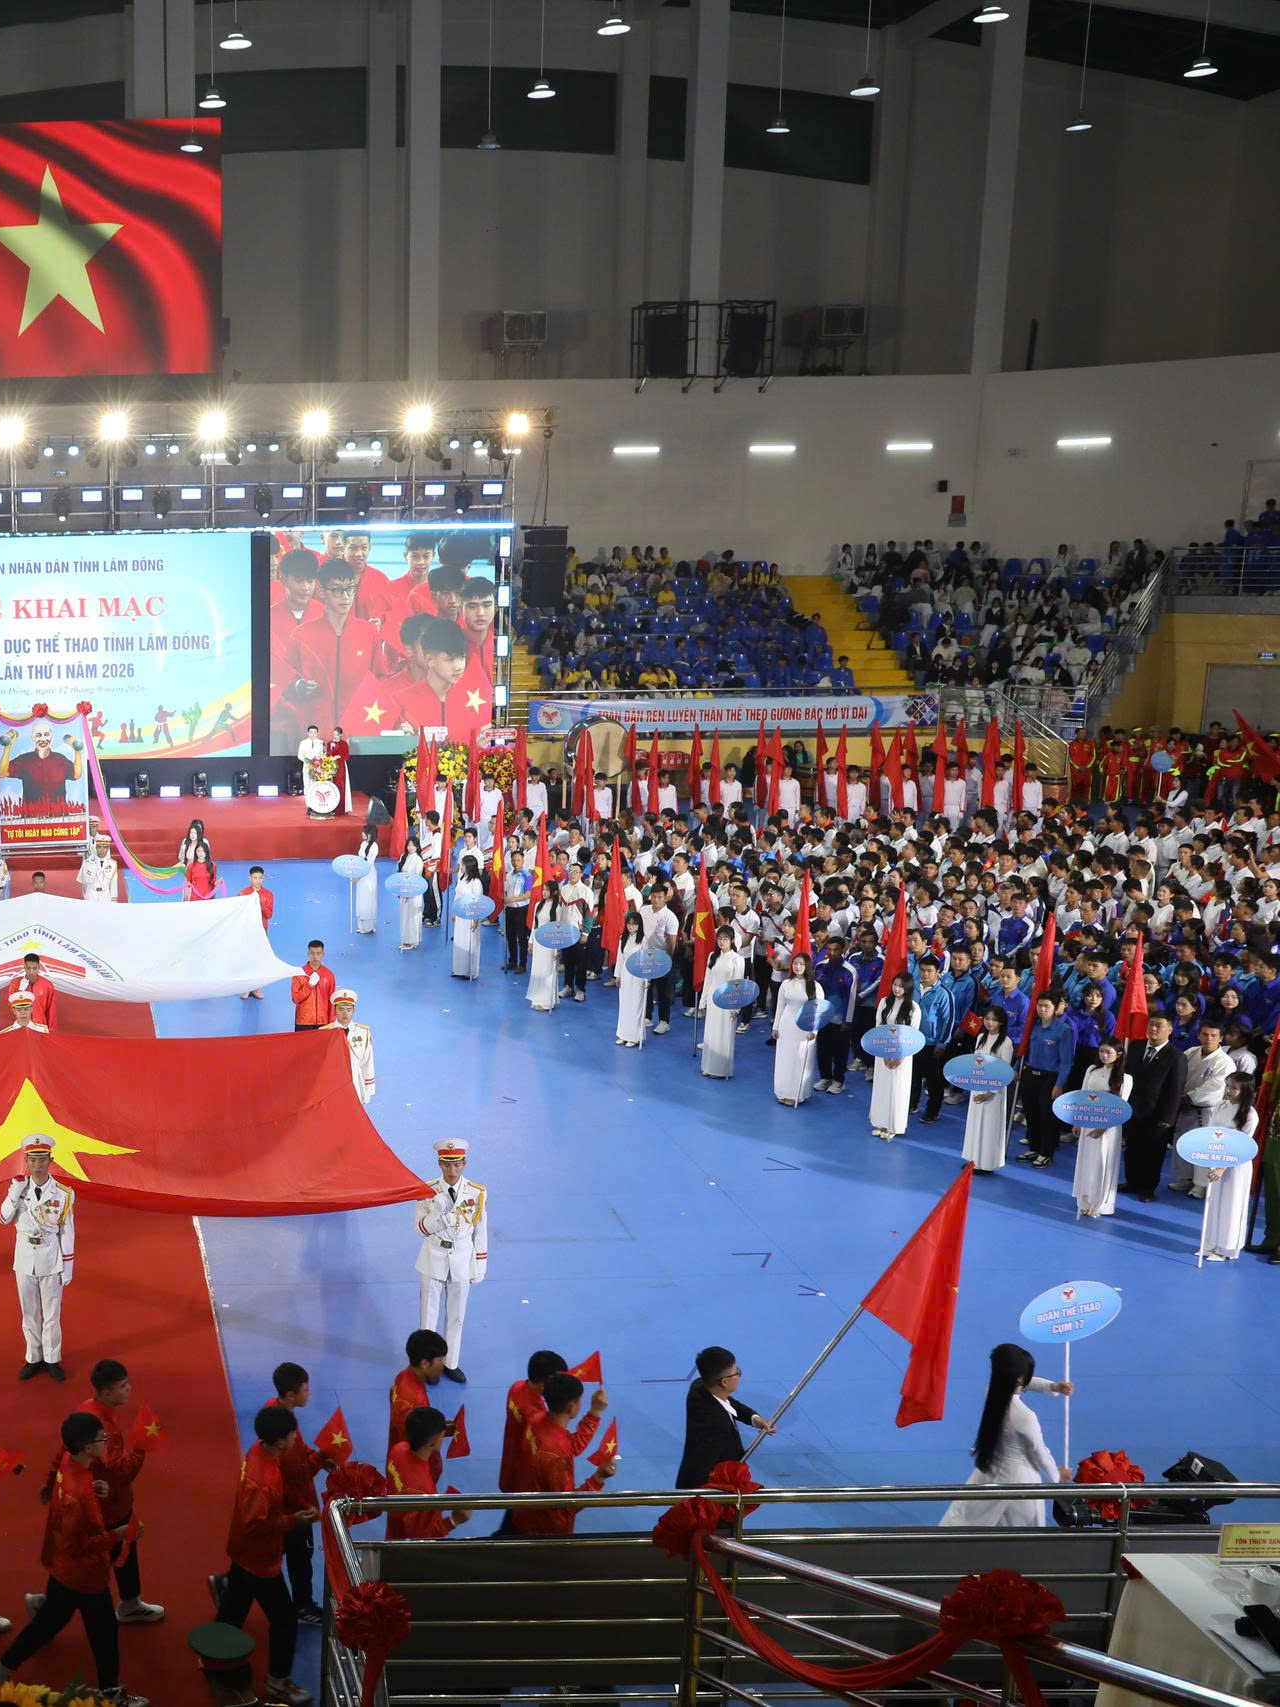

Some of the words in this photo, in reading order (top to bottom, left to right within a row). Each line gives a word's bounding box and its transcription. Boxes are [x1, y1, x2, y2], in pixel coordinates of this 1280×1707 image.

[9, 559, 42, 575] NHÂN
[45, 558, 69, 574] DÂN
[103, 558, 128, 573] LÂM
[13, 597, 88, 620] KHAI
[97, 595, 165, 622] MẠC
[4, 638, 31, 657] DỤC
[35, 631, 61, 653] THỂ
[64, 637, 99, 653] THAO
[103, 632, 134, 652] TỈNH
[139, 633, 168, 651] LÂM
[172, 631, 210, 651] ĐỒNG
[27, 660, 54, 680] THỨ
[57, 664, 61, 680] I
[66, 660, 98, 679] NĂM
[102, 663, 135, 678] 2026
[624, 707, 643, 723] DÂN
[667, 706, 697, 724] LUYỆN
[699, 706, 723, 722] THÂN
[745, 708, 768, 721] THEO
[770, 706, 802, 721] GƯƠNG
[805, 705, 824, 721] BÁC
[852, 706, 868, 722] ĐẠI
[3, 931, 30, 947] THAO
[1211, 1153, 1221, 1161] AN
[1079, 1300, 1101, 1313] THAO
[1075, 1319, 1085, 1330] 17
